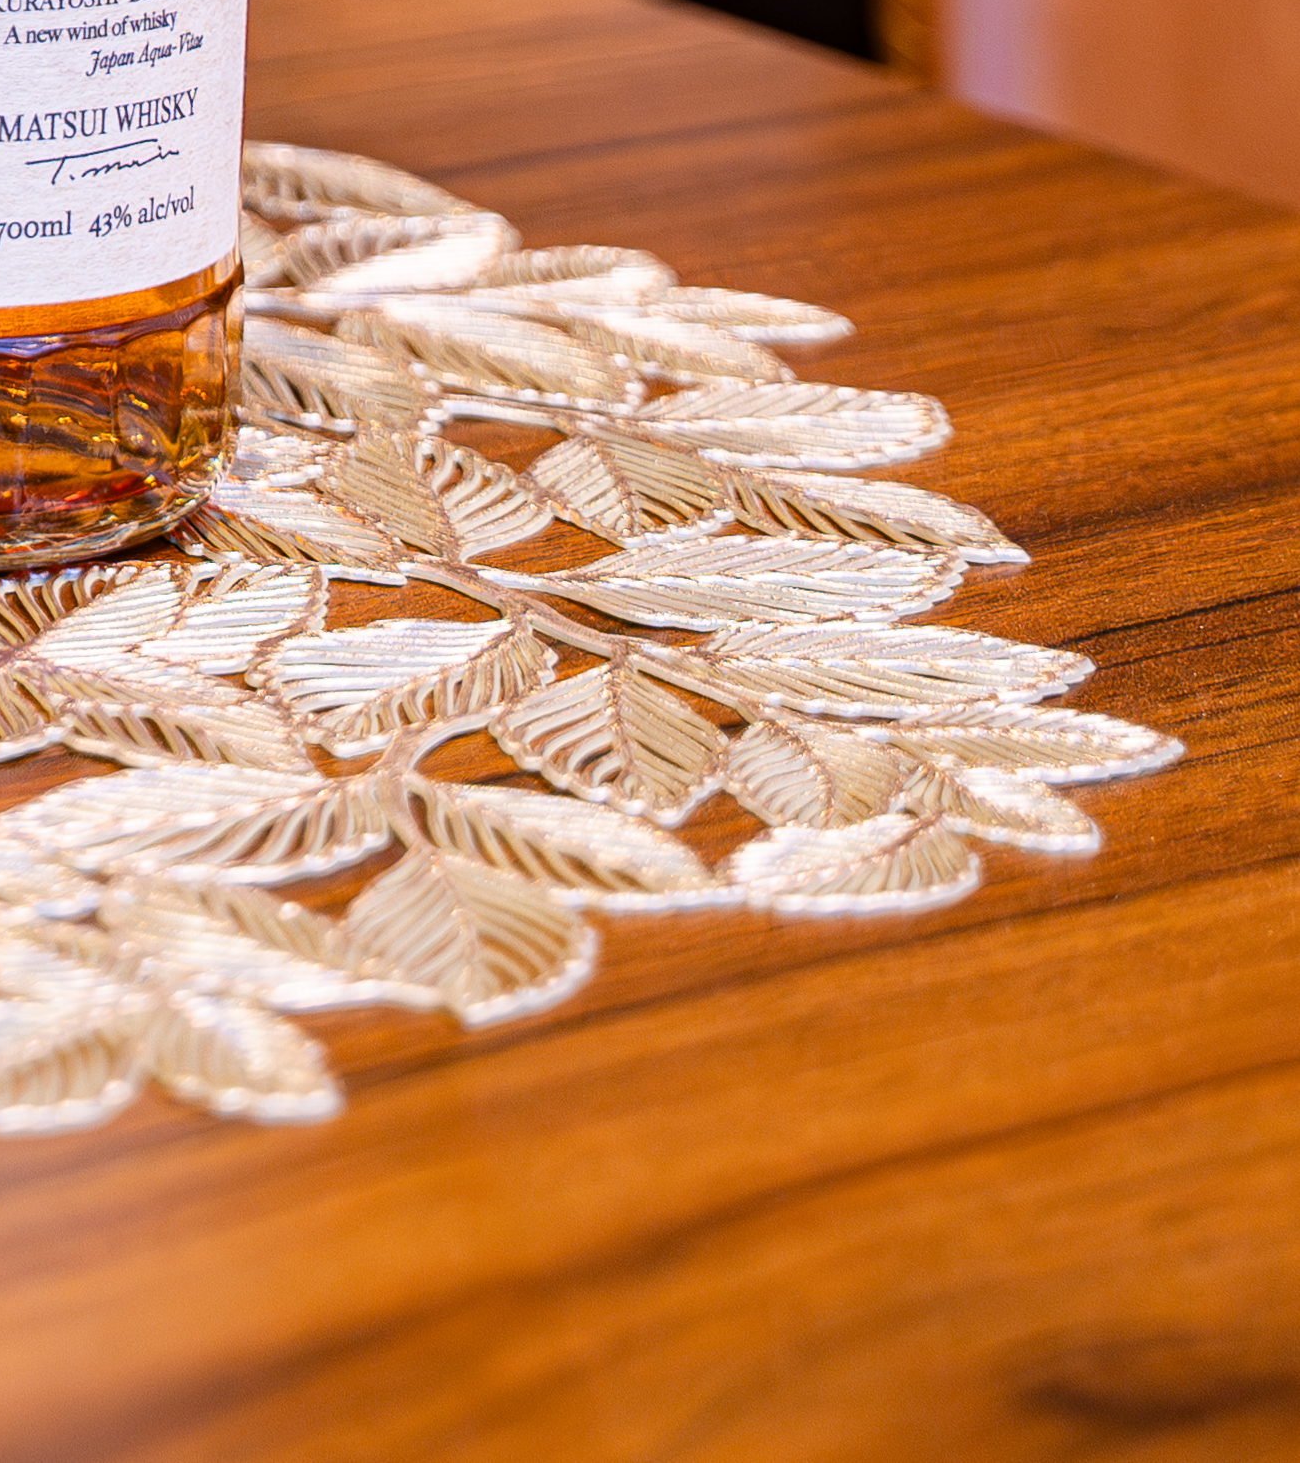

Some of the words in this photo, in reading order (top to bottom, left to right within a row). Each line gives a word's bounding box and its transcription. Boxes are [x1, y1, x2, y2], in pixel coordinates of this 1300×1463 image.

[3, 24, 20, 44] A
[25, 28, 63, 44] new
[67, 18, 108, 41] wind
[111, 15, 129, 36] of
[130, 9, 178, 32] whisky
[86, 50, 134, 77] Japan
[138, 31, 204, 67] Aqua-Vitae
[115, 86, 199, 132] WHISKY
[88, 203, 133, 237] 43%
[137, 184, 195, 225] alc/vol
